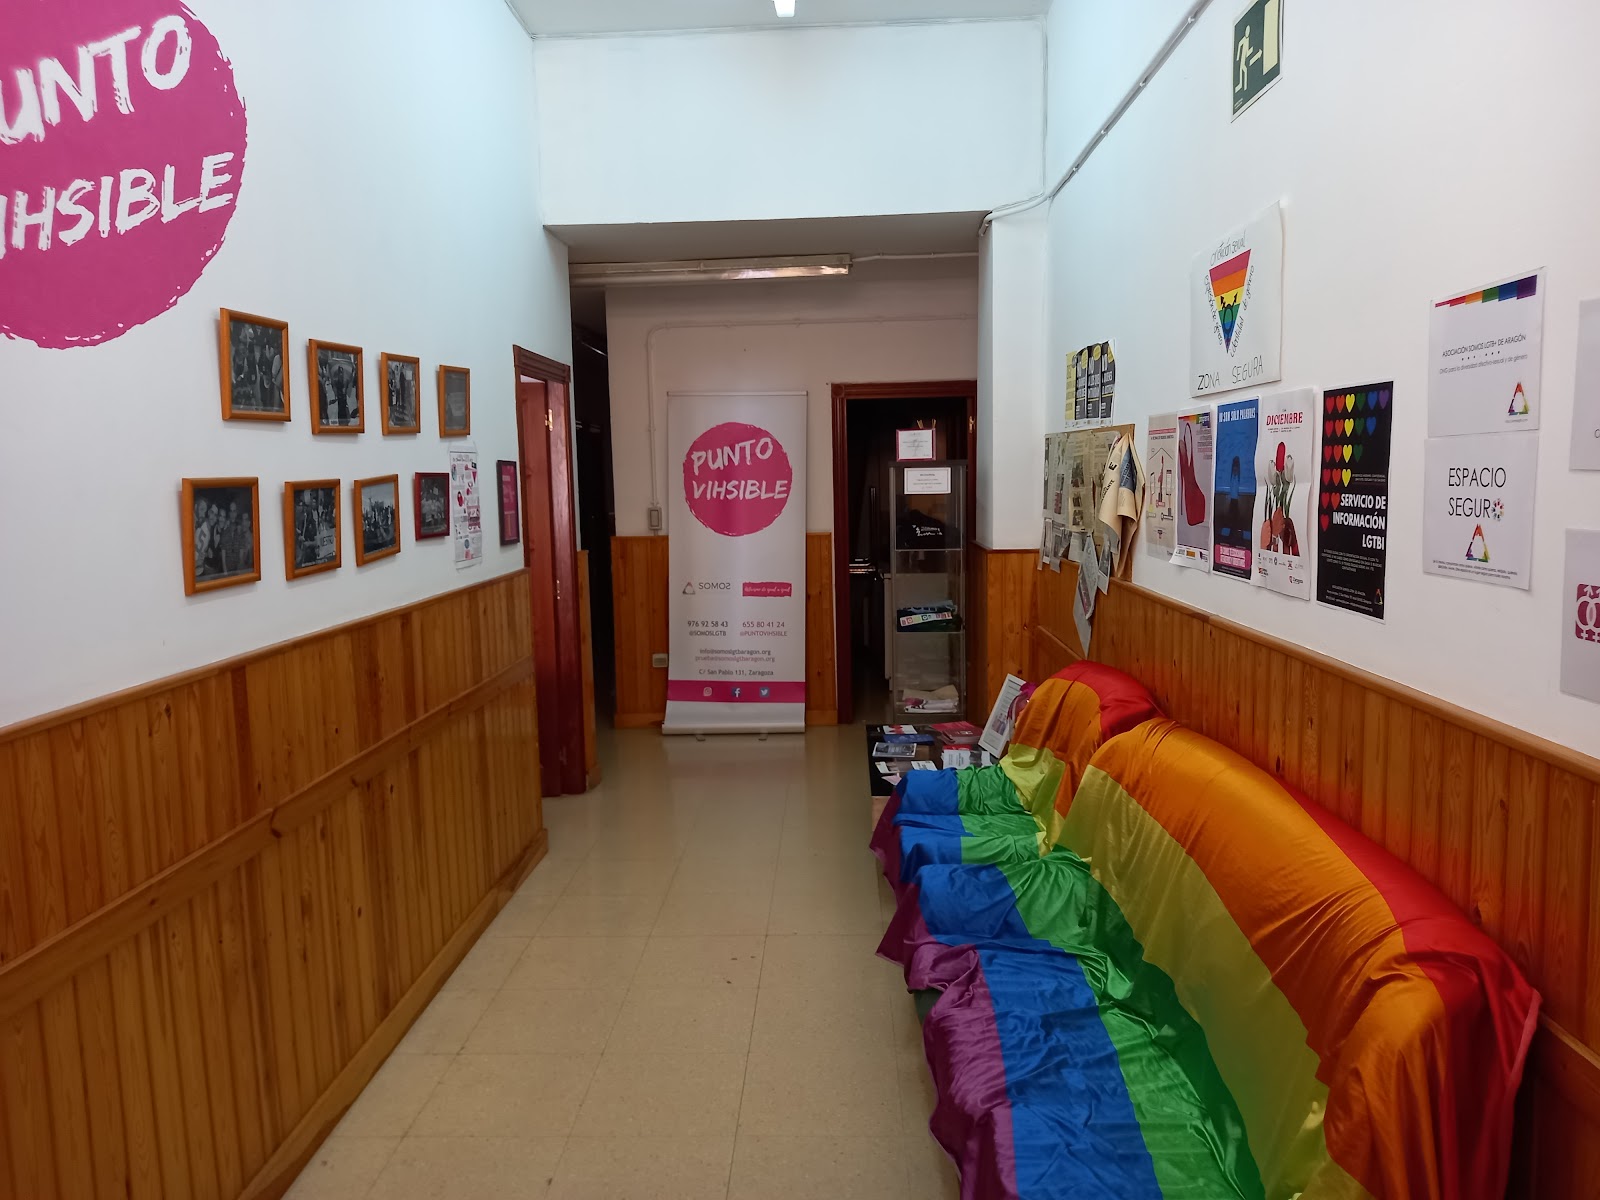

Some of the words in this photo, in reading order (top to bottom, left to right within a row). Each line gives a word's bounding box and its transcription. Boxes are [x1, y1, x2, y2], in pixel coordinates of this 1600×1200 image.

[1468, 342, 1484, 352] SOMOS
[1497, 338, 1504, 346] DE
[1504, 333, 1527, 345] ARAGÓN
[1197, 372, 1221, 391] ZONA
[1231, 355, 1264, 384] SEGURA
[1266, 411, 1304, 426] DICIEMBRE
[691, 437, 774, 476] PUNTO
[1448, 467, 1507, 488] ESPACIO
[692, 479, 788, 500] VIHSIBLE
[1340, 493, 1374, 509] SERVICIO
[1375, 495, 1387, 510] DE
[1332, 511, 1386, 530] INFORMACIÓN
[1362, 533, 1385, 550] LGTBI
[687, 620, 700, 628] 976
[701, 620, 709, 628] 92
[711, 620, 719, 628] 58
[720, 620, 729, 628] 43
[748, 669, 774, 677] Zaragoza
